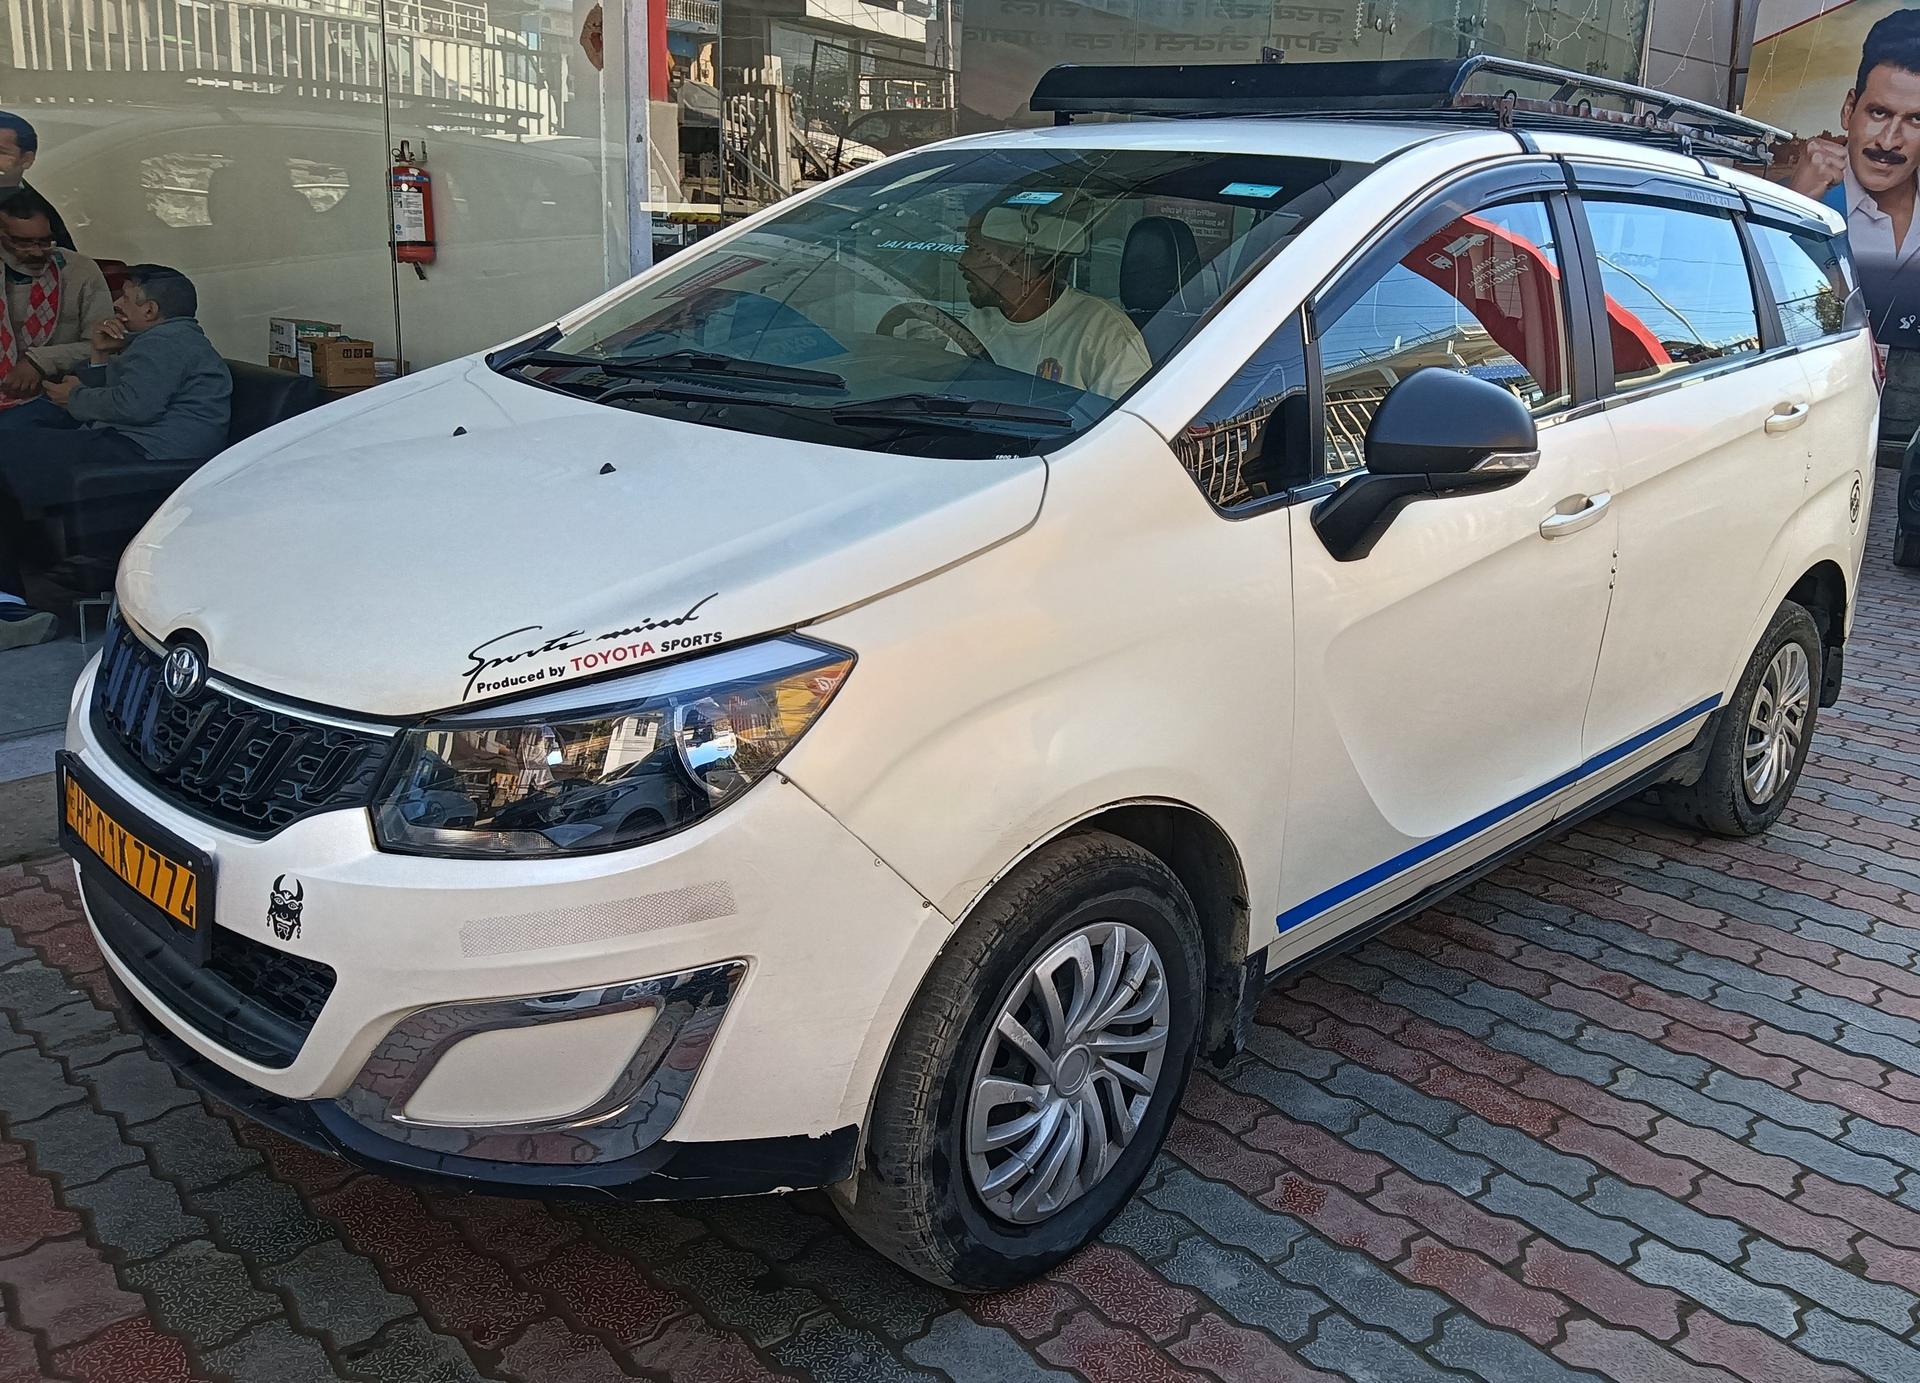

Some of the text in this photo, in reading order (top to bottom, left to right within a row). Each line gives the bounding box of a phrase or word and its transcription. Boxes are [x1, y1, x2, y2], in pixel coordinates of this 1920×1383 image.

[877, 240, 903, 249] JAI
[596, 592, 719, 641] mind
[477, 631, 723, 693] Produced by TOYOTA SPORTS
